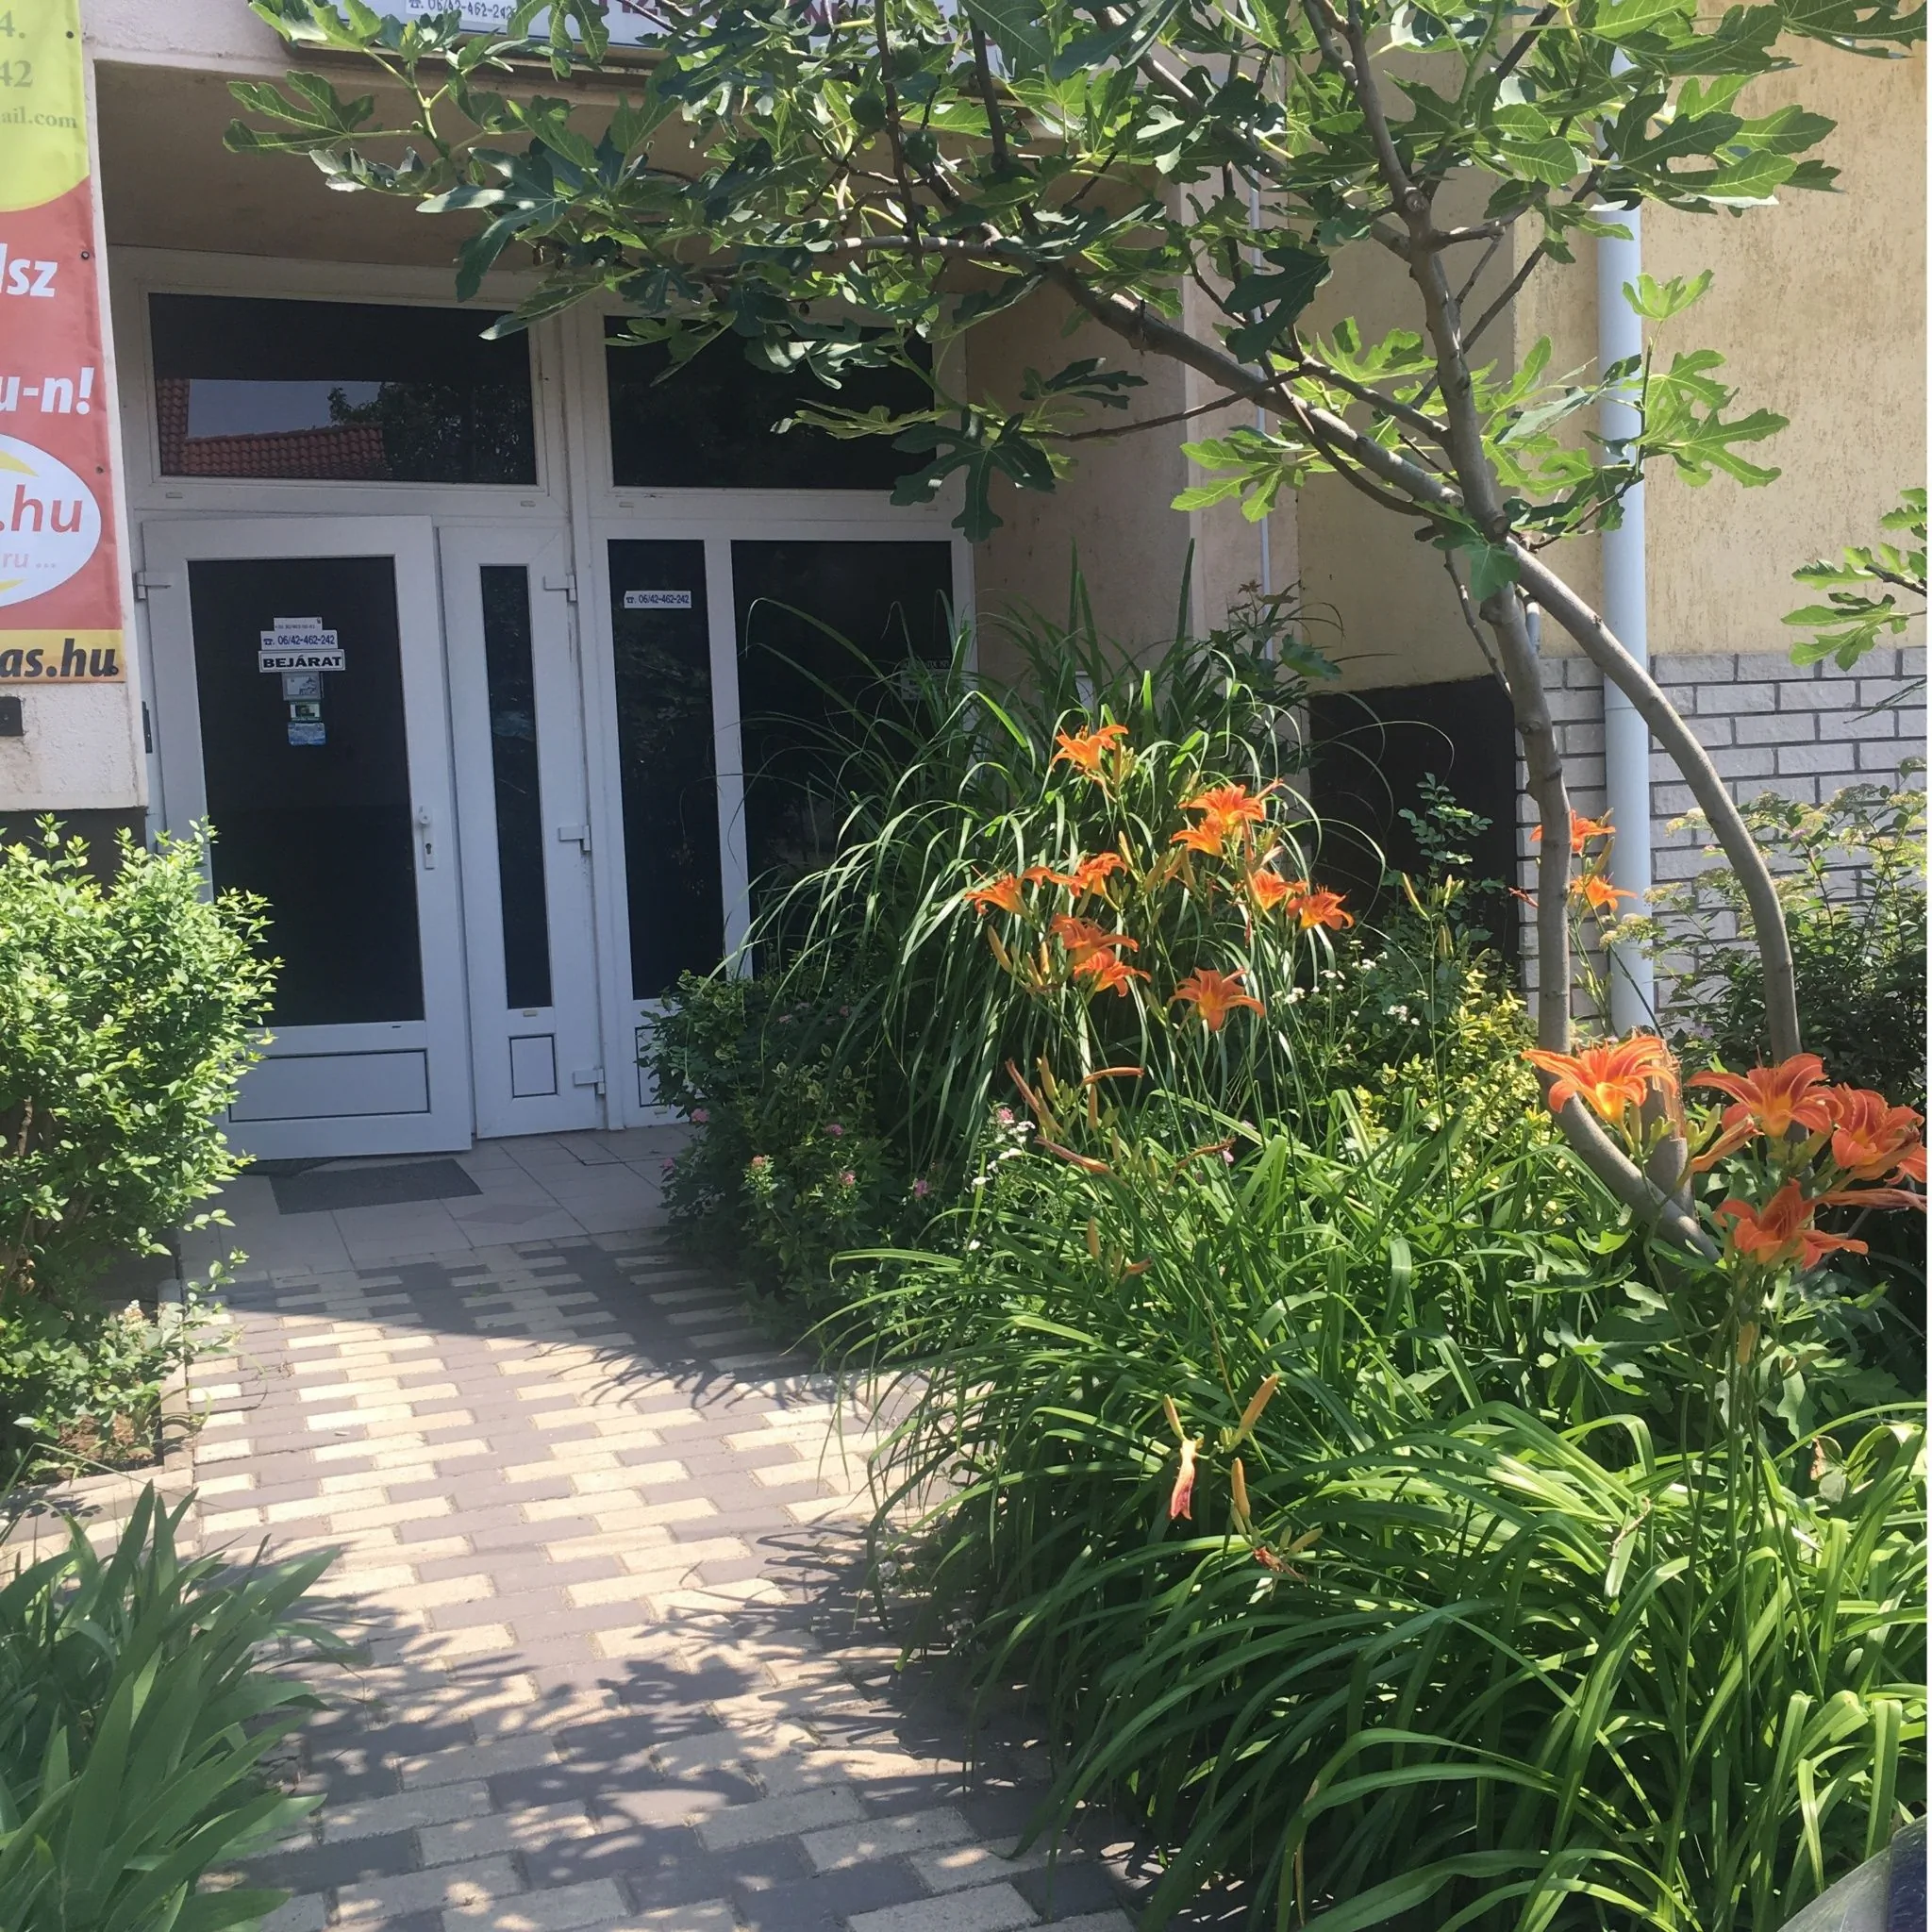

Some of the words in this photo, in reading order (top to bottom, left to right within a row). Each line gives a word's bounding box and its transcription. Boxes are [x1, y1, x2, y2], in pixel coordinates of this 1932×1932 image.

[0, 59, 33, 88] 42
[1, 106, 77, 129] ail.com
[639, 594, 690, 604] 06/42-462-242
[277, 635, 335, 645] 06/42-462-242
[0, 638, 116, 678] as.hu
[263, 654, 342, 669] BEJÁRAT
